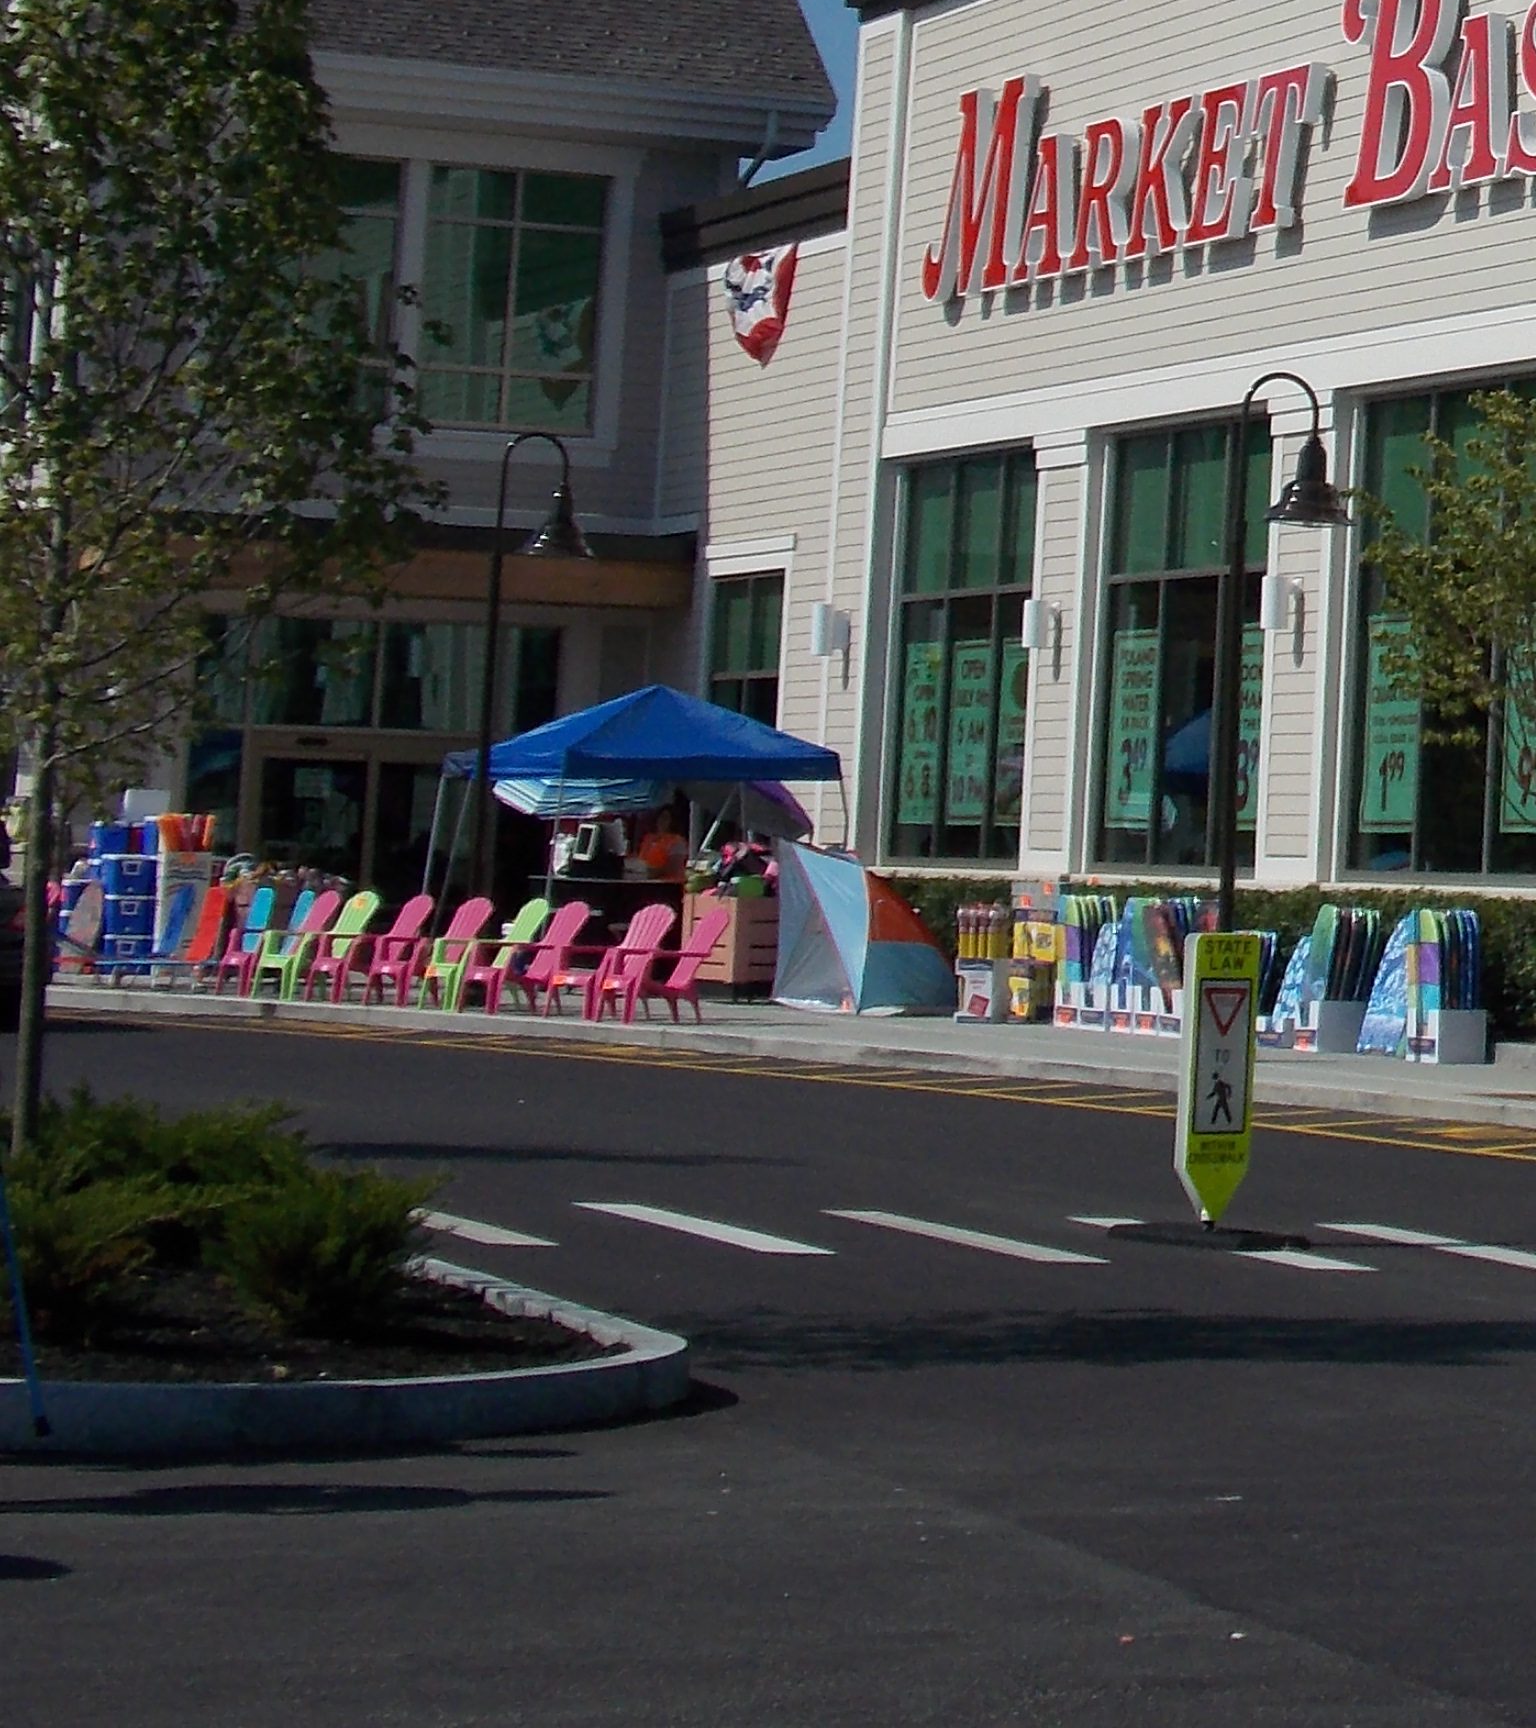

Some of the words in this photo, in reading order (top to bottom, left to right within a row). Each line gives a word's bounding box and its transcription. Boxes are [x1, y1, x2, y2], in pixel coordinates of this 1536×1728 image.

[921, 60, 1335, 303] MARKET
[1205, 939, 1253, 955] STATE
[1209, 956, 1245, 971] LAW
[1215, 1048, 1230, 1065] TO
